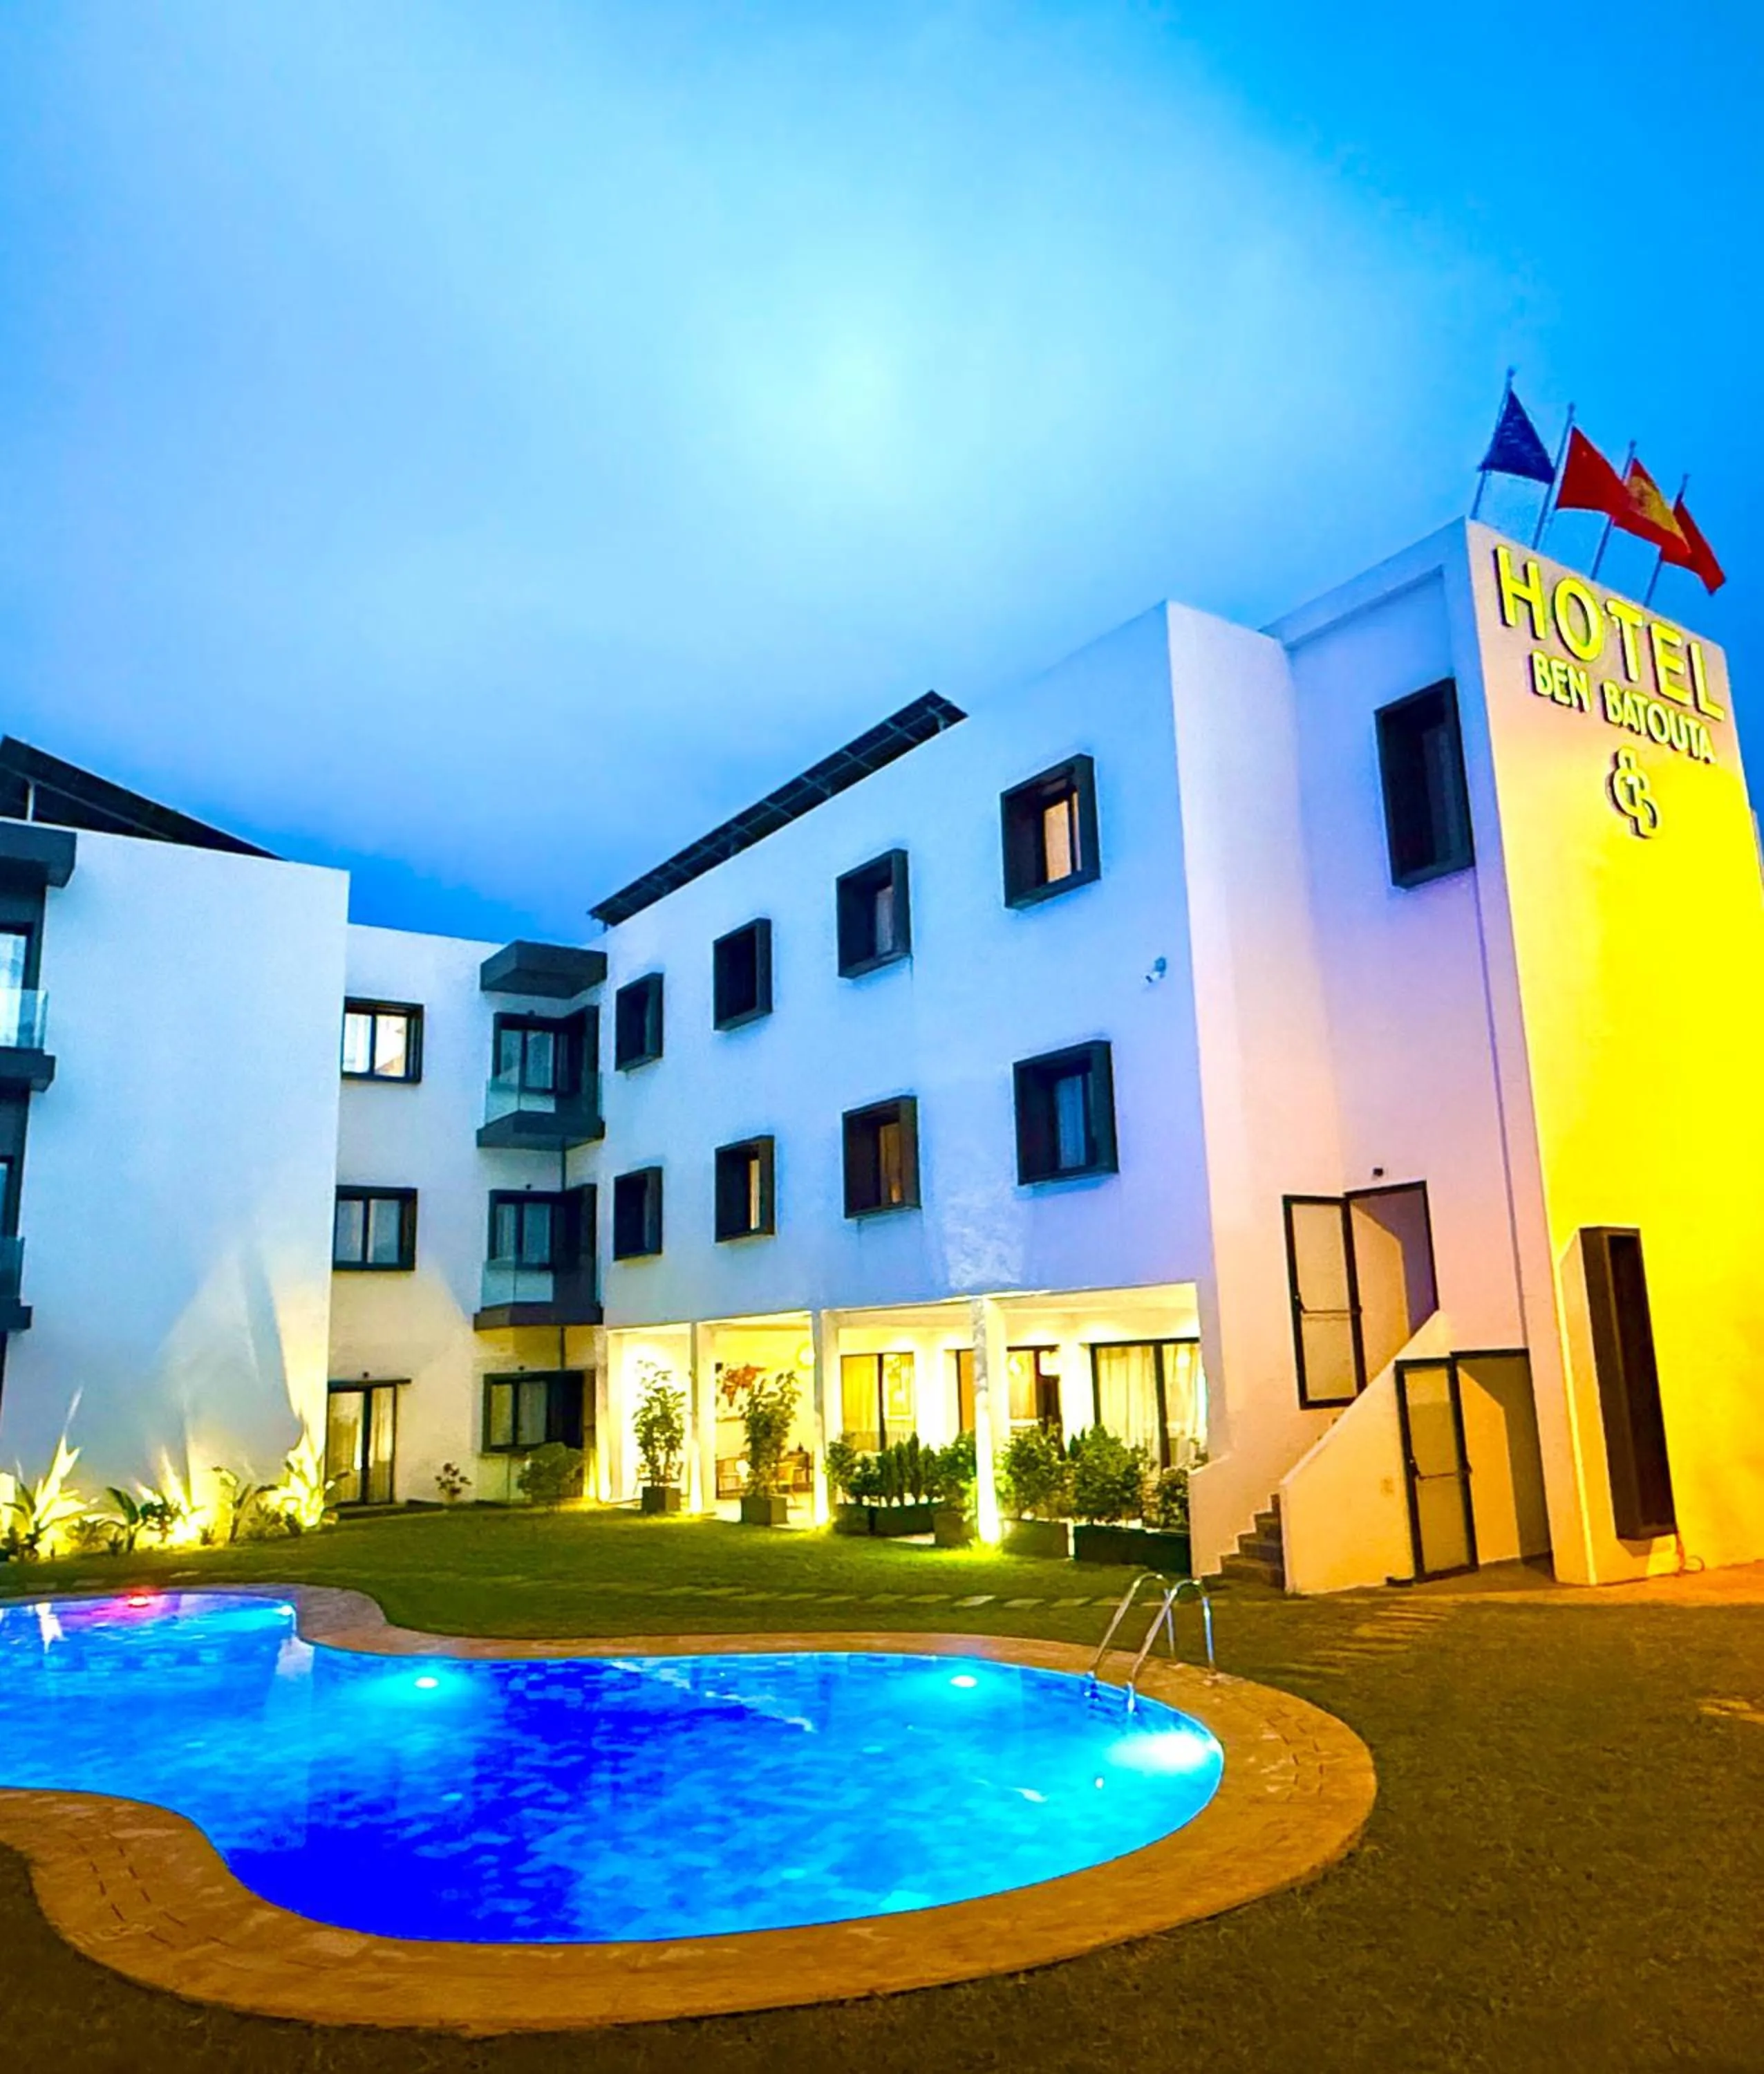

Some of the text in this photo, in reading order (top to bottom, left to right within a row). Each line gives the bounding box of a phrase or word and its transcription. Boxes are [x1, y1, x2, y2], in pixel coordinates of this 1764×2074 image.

[1495, 545, 1725, 720] HOTEL
[1531, 651, 1716, 764] BEN BATOUTA
